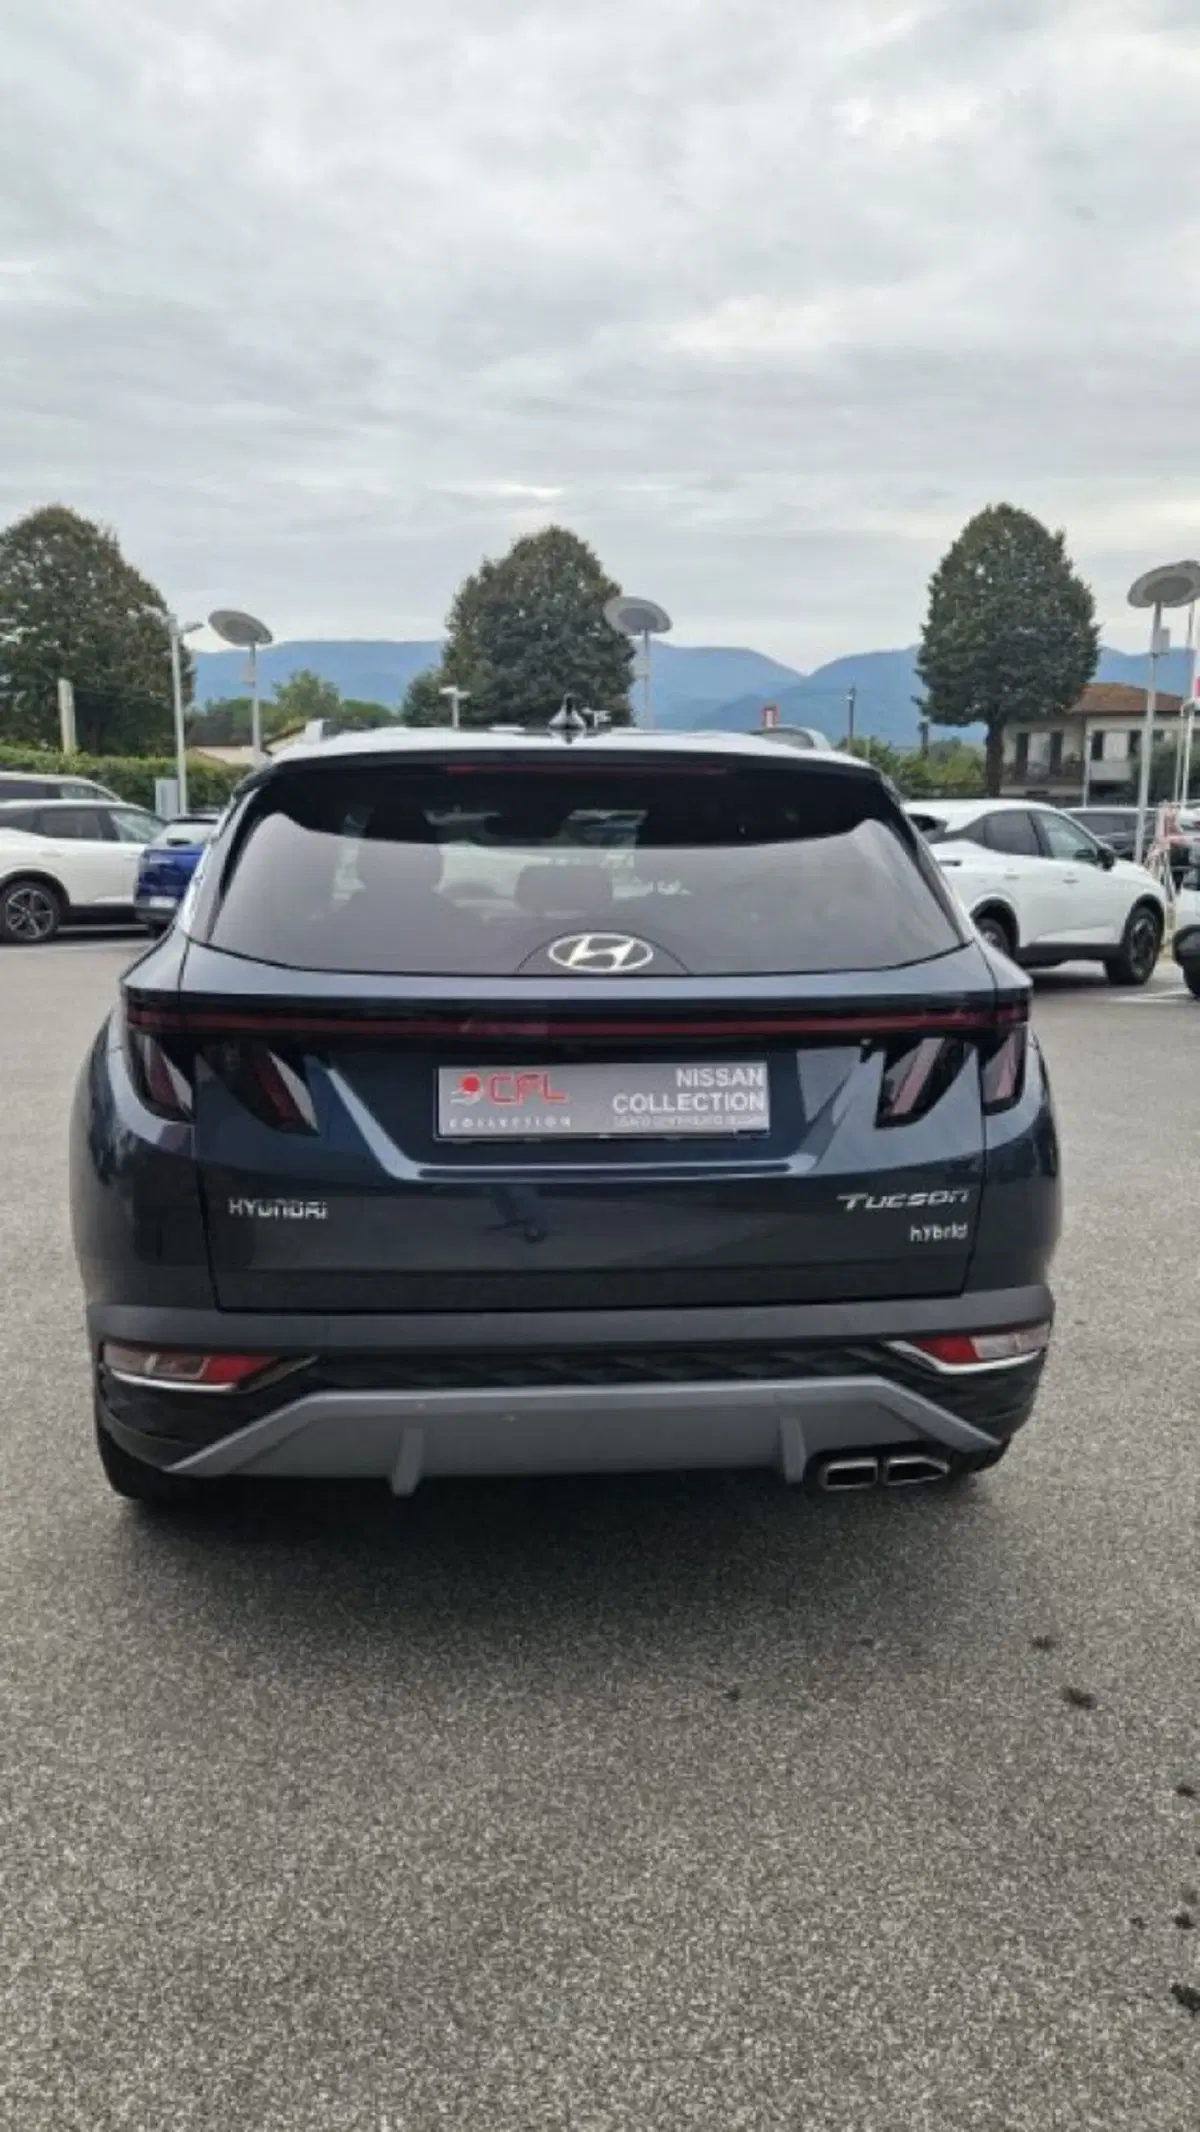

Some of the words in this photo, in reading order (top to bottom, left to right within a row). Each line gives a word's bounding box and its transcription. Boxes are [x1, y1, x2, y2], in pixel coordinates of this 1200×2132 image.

[675, 1067, 764, 1087] NISSAN
[612, 1092, 764, 1113] COLLECTION
[228, 1198, 328, 1219] HYUNDAI
